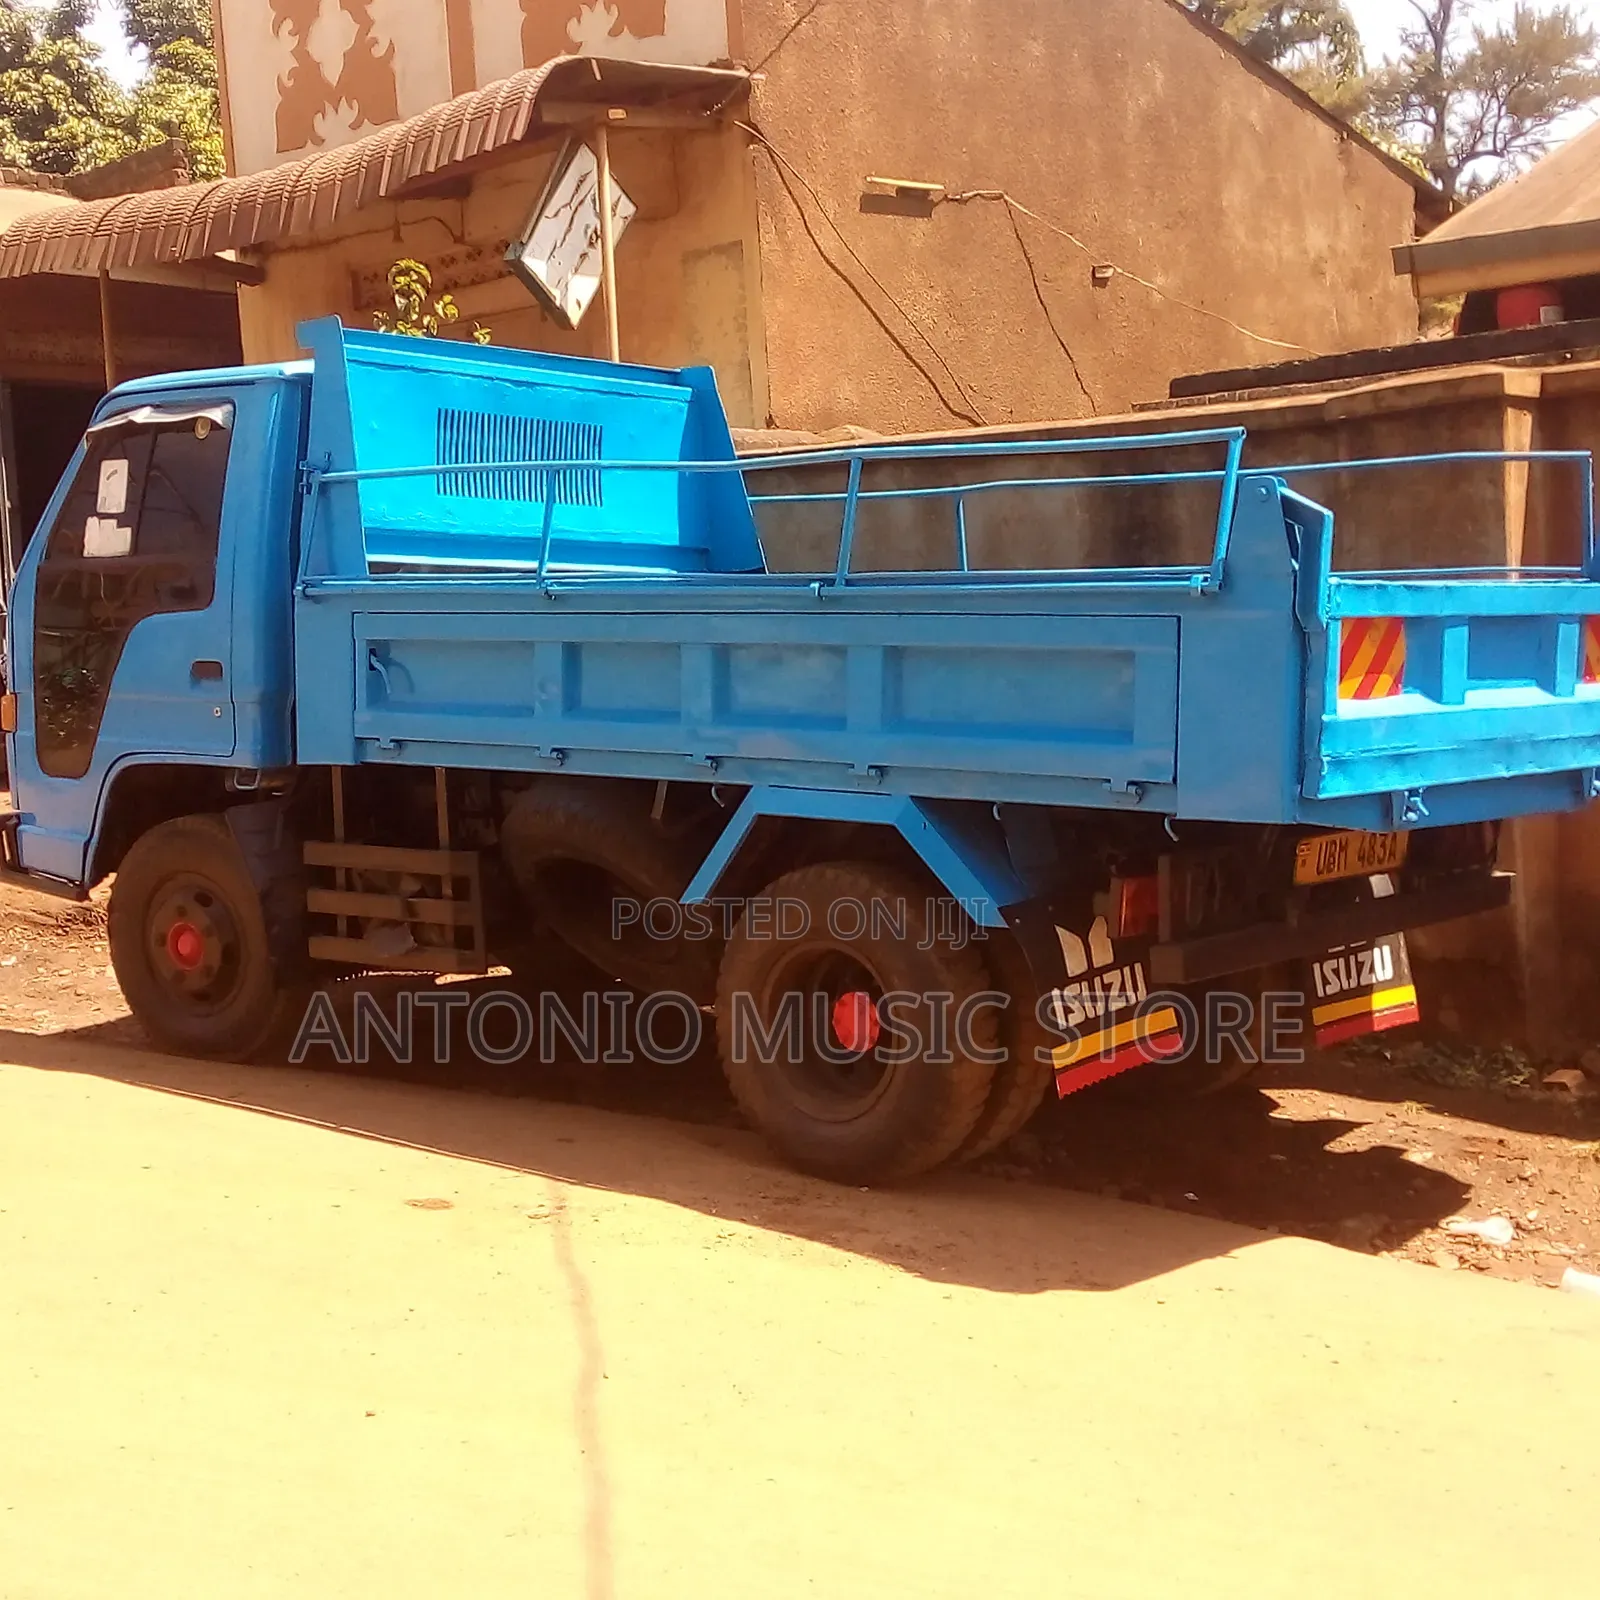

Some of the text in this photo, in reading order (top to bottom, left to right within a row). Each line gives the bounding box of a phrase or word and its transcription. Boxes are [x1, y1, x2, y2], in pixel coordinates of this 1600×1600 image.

[1316, 832, 1398, 876] UBM 483A
[1051, 962, 1147, 1030] ISUZU
[1312, 945, 1394, 998] ISUZU
